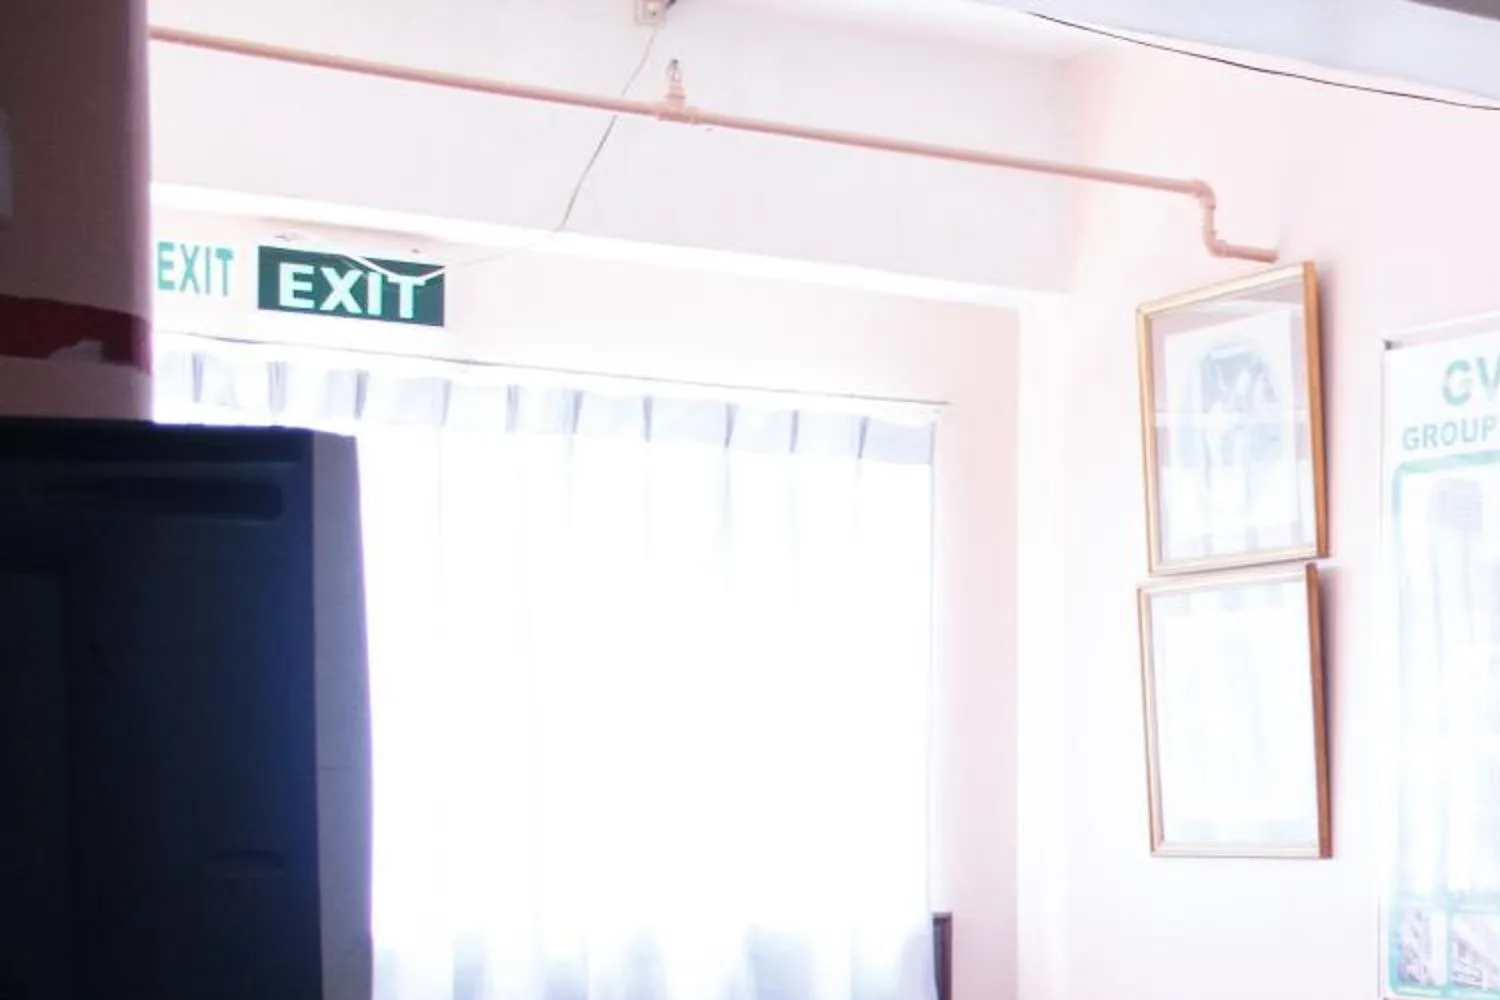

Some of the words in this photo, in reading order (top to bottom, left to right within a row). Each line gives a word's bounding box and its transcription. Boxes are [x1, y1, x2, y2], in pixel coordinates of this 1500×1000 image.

[157, 240, 234, 297] EXIT
[278, 261, 427, 320] EXIT
[1402, 414, 1498, 451] GROUP
